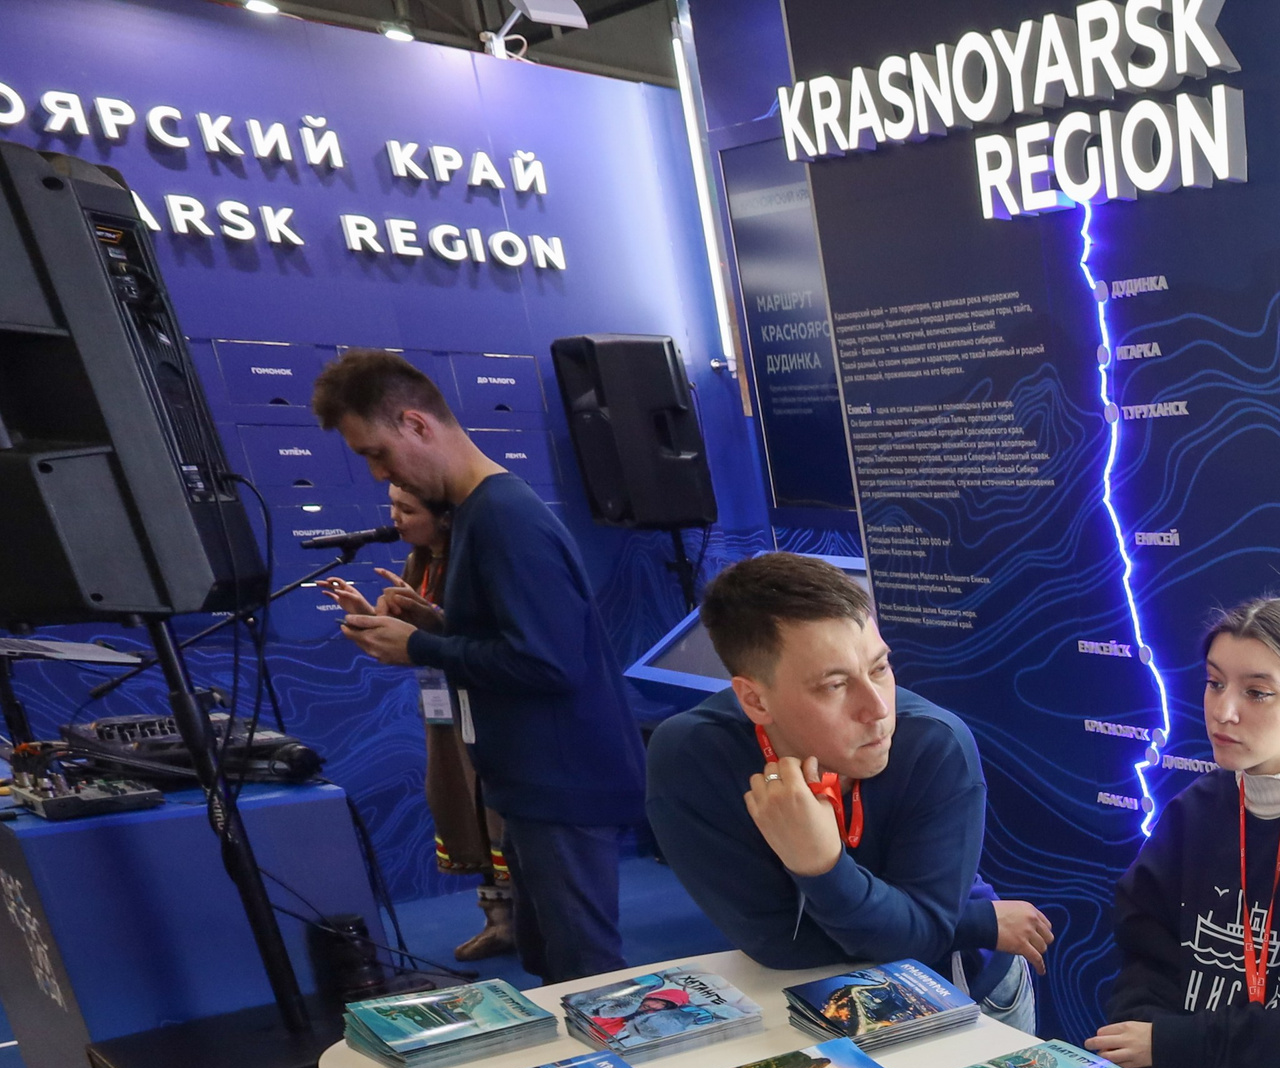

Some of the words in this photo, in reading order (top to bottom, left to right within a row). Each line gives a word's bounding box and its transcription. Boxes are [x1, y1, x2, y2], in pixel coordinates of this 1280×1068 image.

[777, 0, 1238, 162] KRASNOYARSK
[975, 84, 1247, 219] REGION
[387, 139, 548, 195] КРАЙ
[340, 213, 567, 270] REGION
[1112, 276, 1168, 298] ДУДИНКА
[757, 291, 812, 312] МАРШРУТ
[251, 367, 292, 375] ГОМОНОК
[766, 352, 822, 373] ДУДИНКА
[1121, 401, 1189, 419] ТУРУХАНСК
[279, 447, 311, 456] КУЛЁМА
[1135, 529, 1180, 546] ЕНИСЕЙ
[1078, 640, 1132, 657] ЕНИСЕЙСК
[1085, 719, 1150, 741] КРАСНОЯРСК
